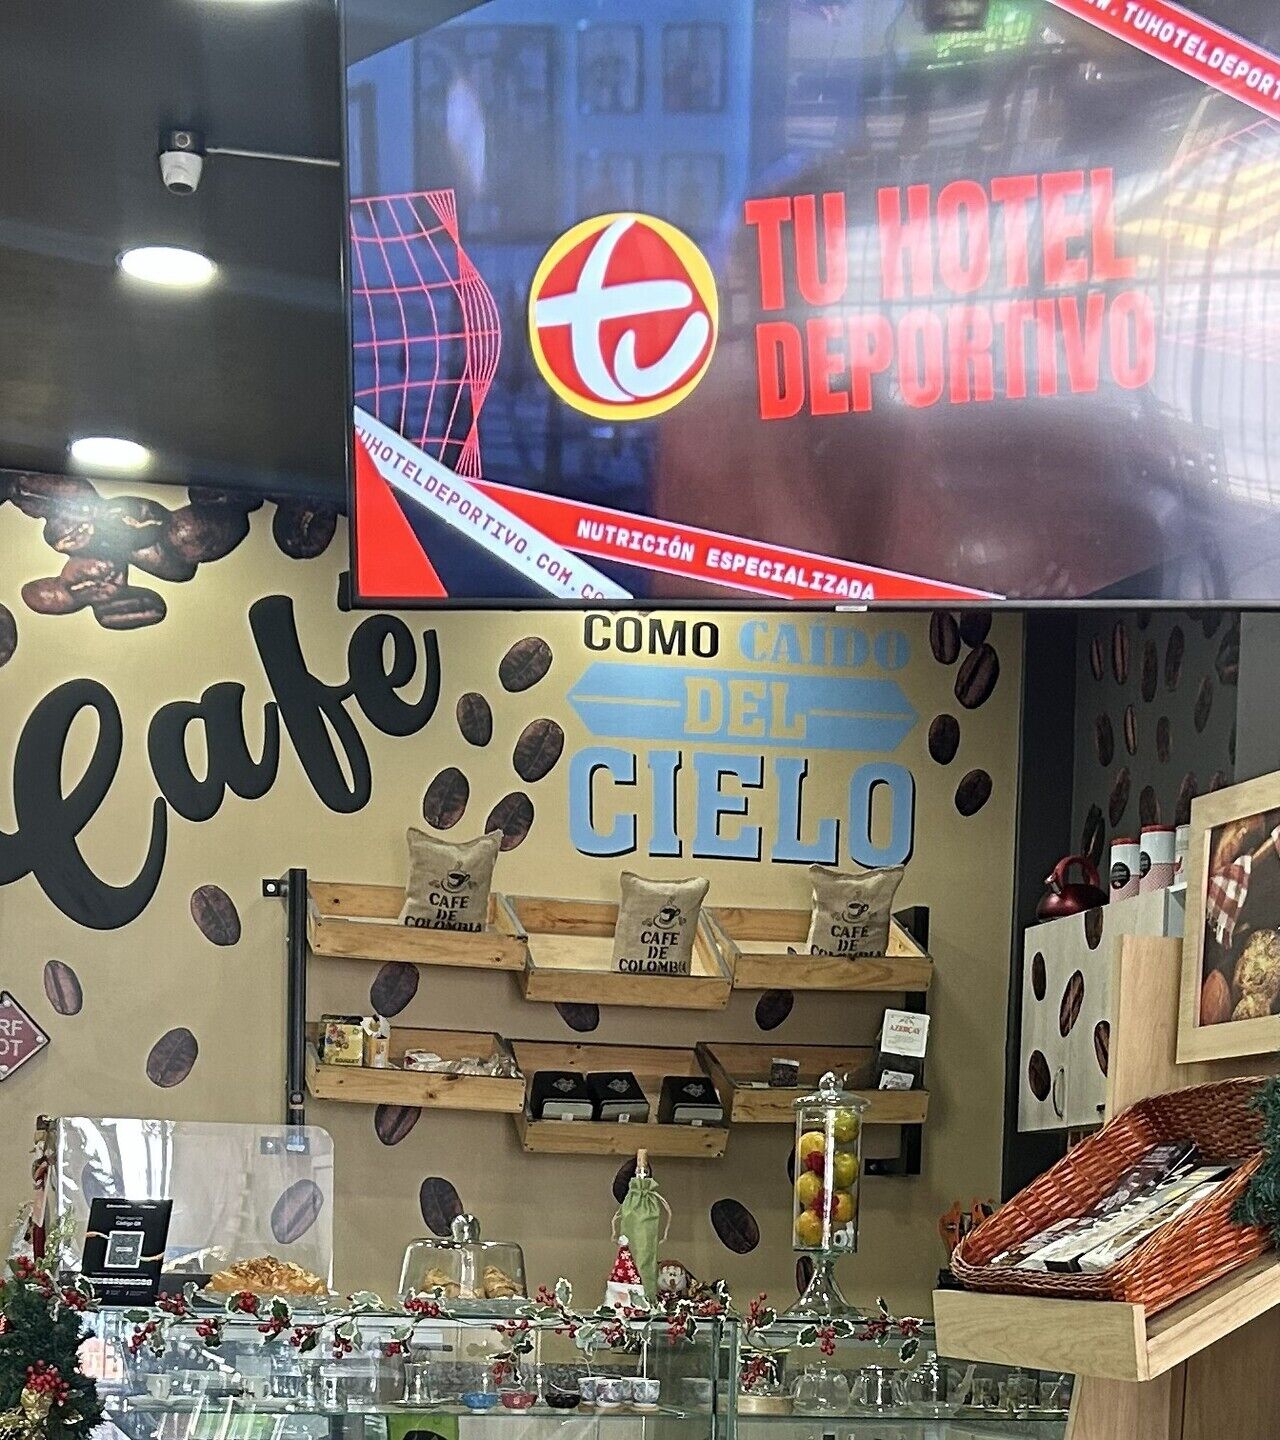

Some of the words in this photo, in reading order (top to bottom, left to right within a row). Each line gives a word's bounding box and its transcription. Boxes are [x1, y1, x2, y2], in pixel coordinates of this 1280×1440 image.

[745, 191, 849, 311] TU
[877, 167, 1138, 299] HOTEL
[755, 290, 1157, 420] DEPORTIVO
[576, 518, 695, 562] NUTRICIÓN
[706, 547, 875, 600] ESPECIALIZADA
[583, 613, 720, 659] COMO
[682, 676, 807, 740] DEL
[569, 745, 916, 870] CIELO
[429, 891, 471, 909] CAFE
[436, 908, 458, 922] DE
[640, 931, 681, 946] CAFE
[831, 924, 870, 939] CAFE
[837, 939, 859, 952] DE
[647, 946, 669, 960] DE
